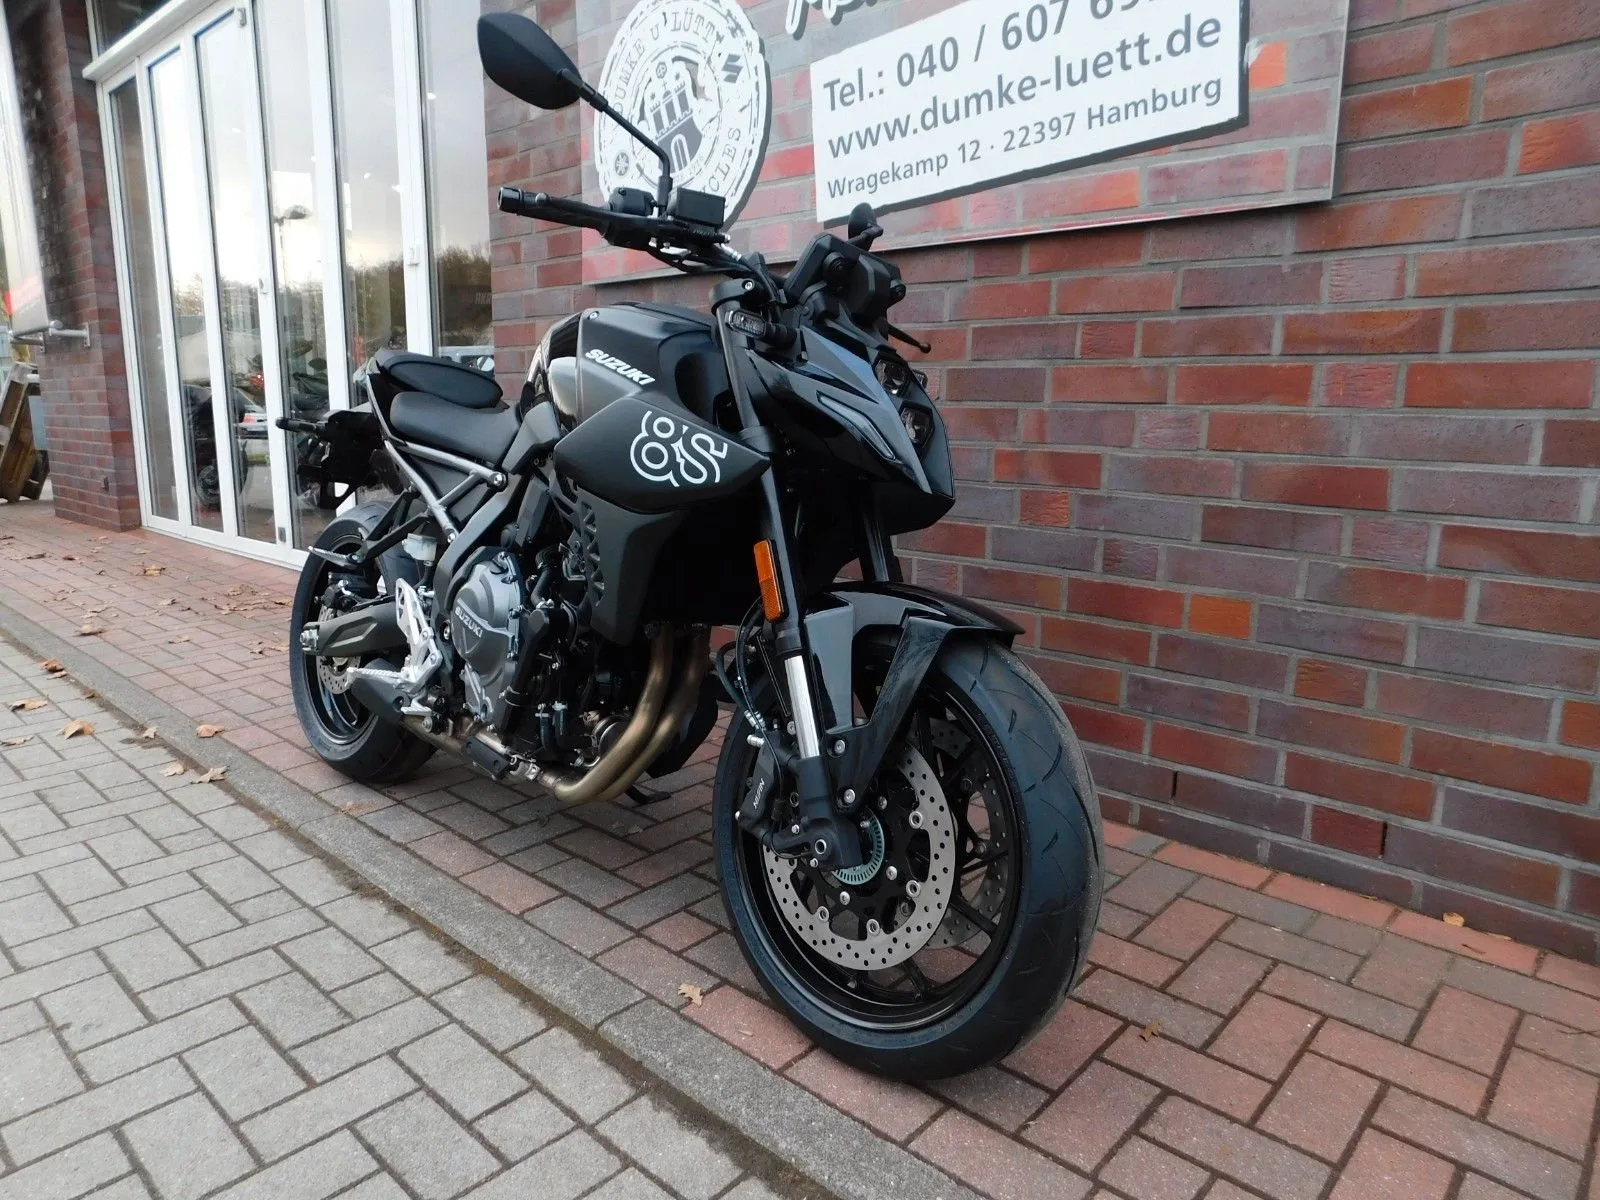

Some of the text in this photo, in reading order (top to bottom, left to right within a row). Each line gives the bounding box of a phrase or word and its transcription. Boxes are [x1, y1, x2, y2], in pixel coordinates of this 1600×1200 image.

[671, 8, 716, 43] LÜTT
[823, 67, 884, 111] Tel.:
[896, 37, 959, 87] 040
[1001, 0, 1069, 51] 607
[828, 13, 1221, 159] www.dumke-luett.de
[827, 153, 949, 198] Wragekamp
[957, 139, 981, 164] 12
[1003, 112, 1076, 153] 22397
[1087, 78, 1221, 130] Hamburg
[584, 348, 656, 386] SUZUKI
[454, 605, 483, 639] SUZUKI
